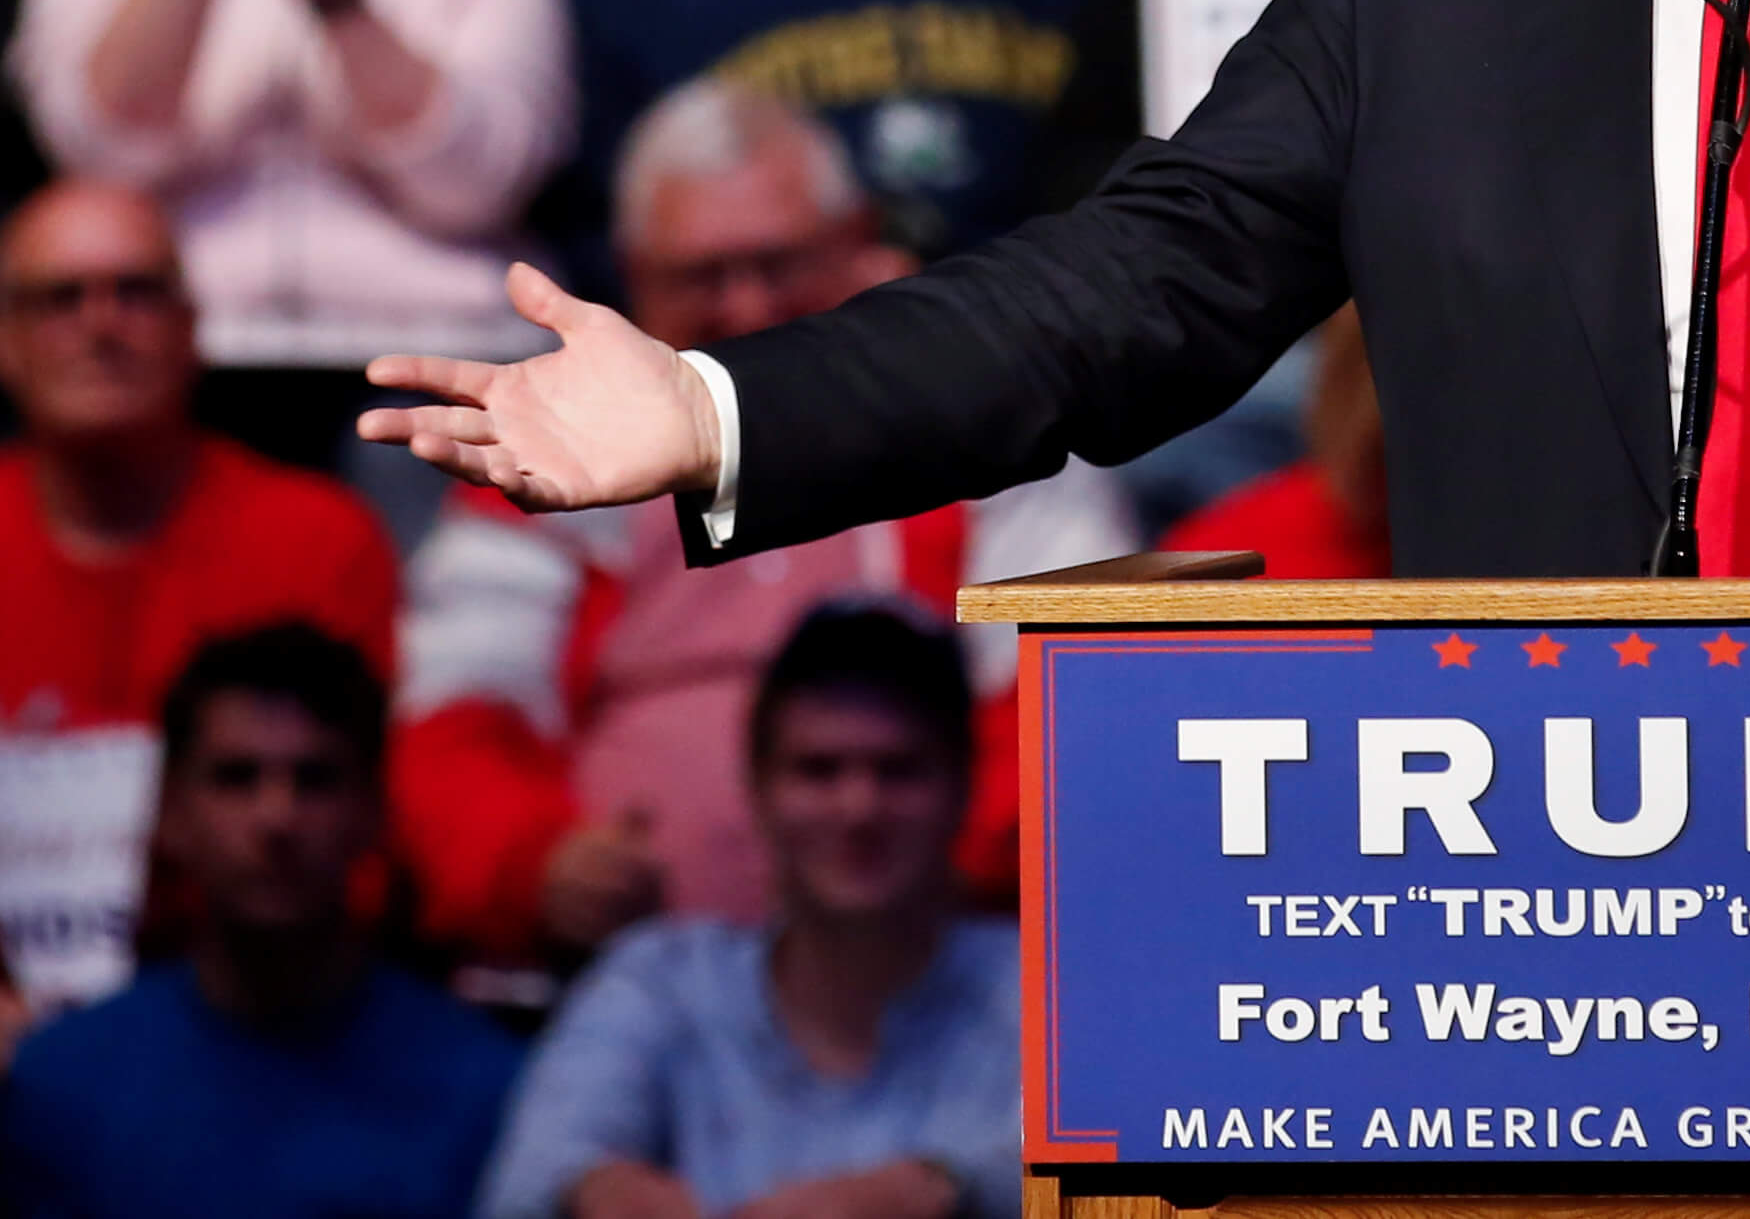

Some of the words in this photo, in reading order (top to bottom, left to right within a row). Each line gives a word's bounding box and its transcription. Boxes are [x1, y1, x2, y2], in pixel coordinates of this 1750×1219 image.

[1246, 895, 1398, 937] TEXT
[1219, 984, 1390, 1042] Fort
[1415, 983, 1719, 1056] Wayne,
[1162, 1108, 1334, 1149] MAKE
[1362, 1107, 1649, 1149] AMERICA
